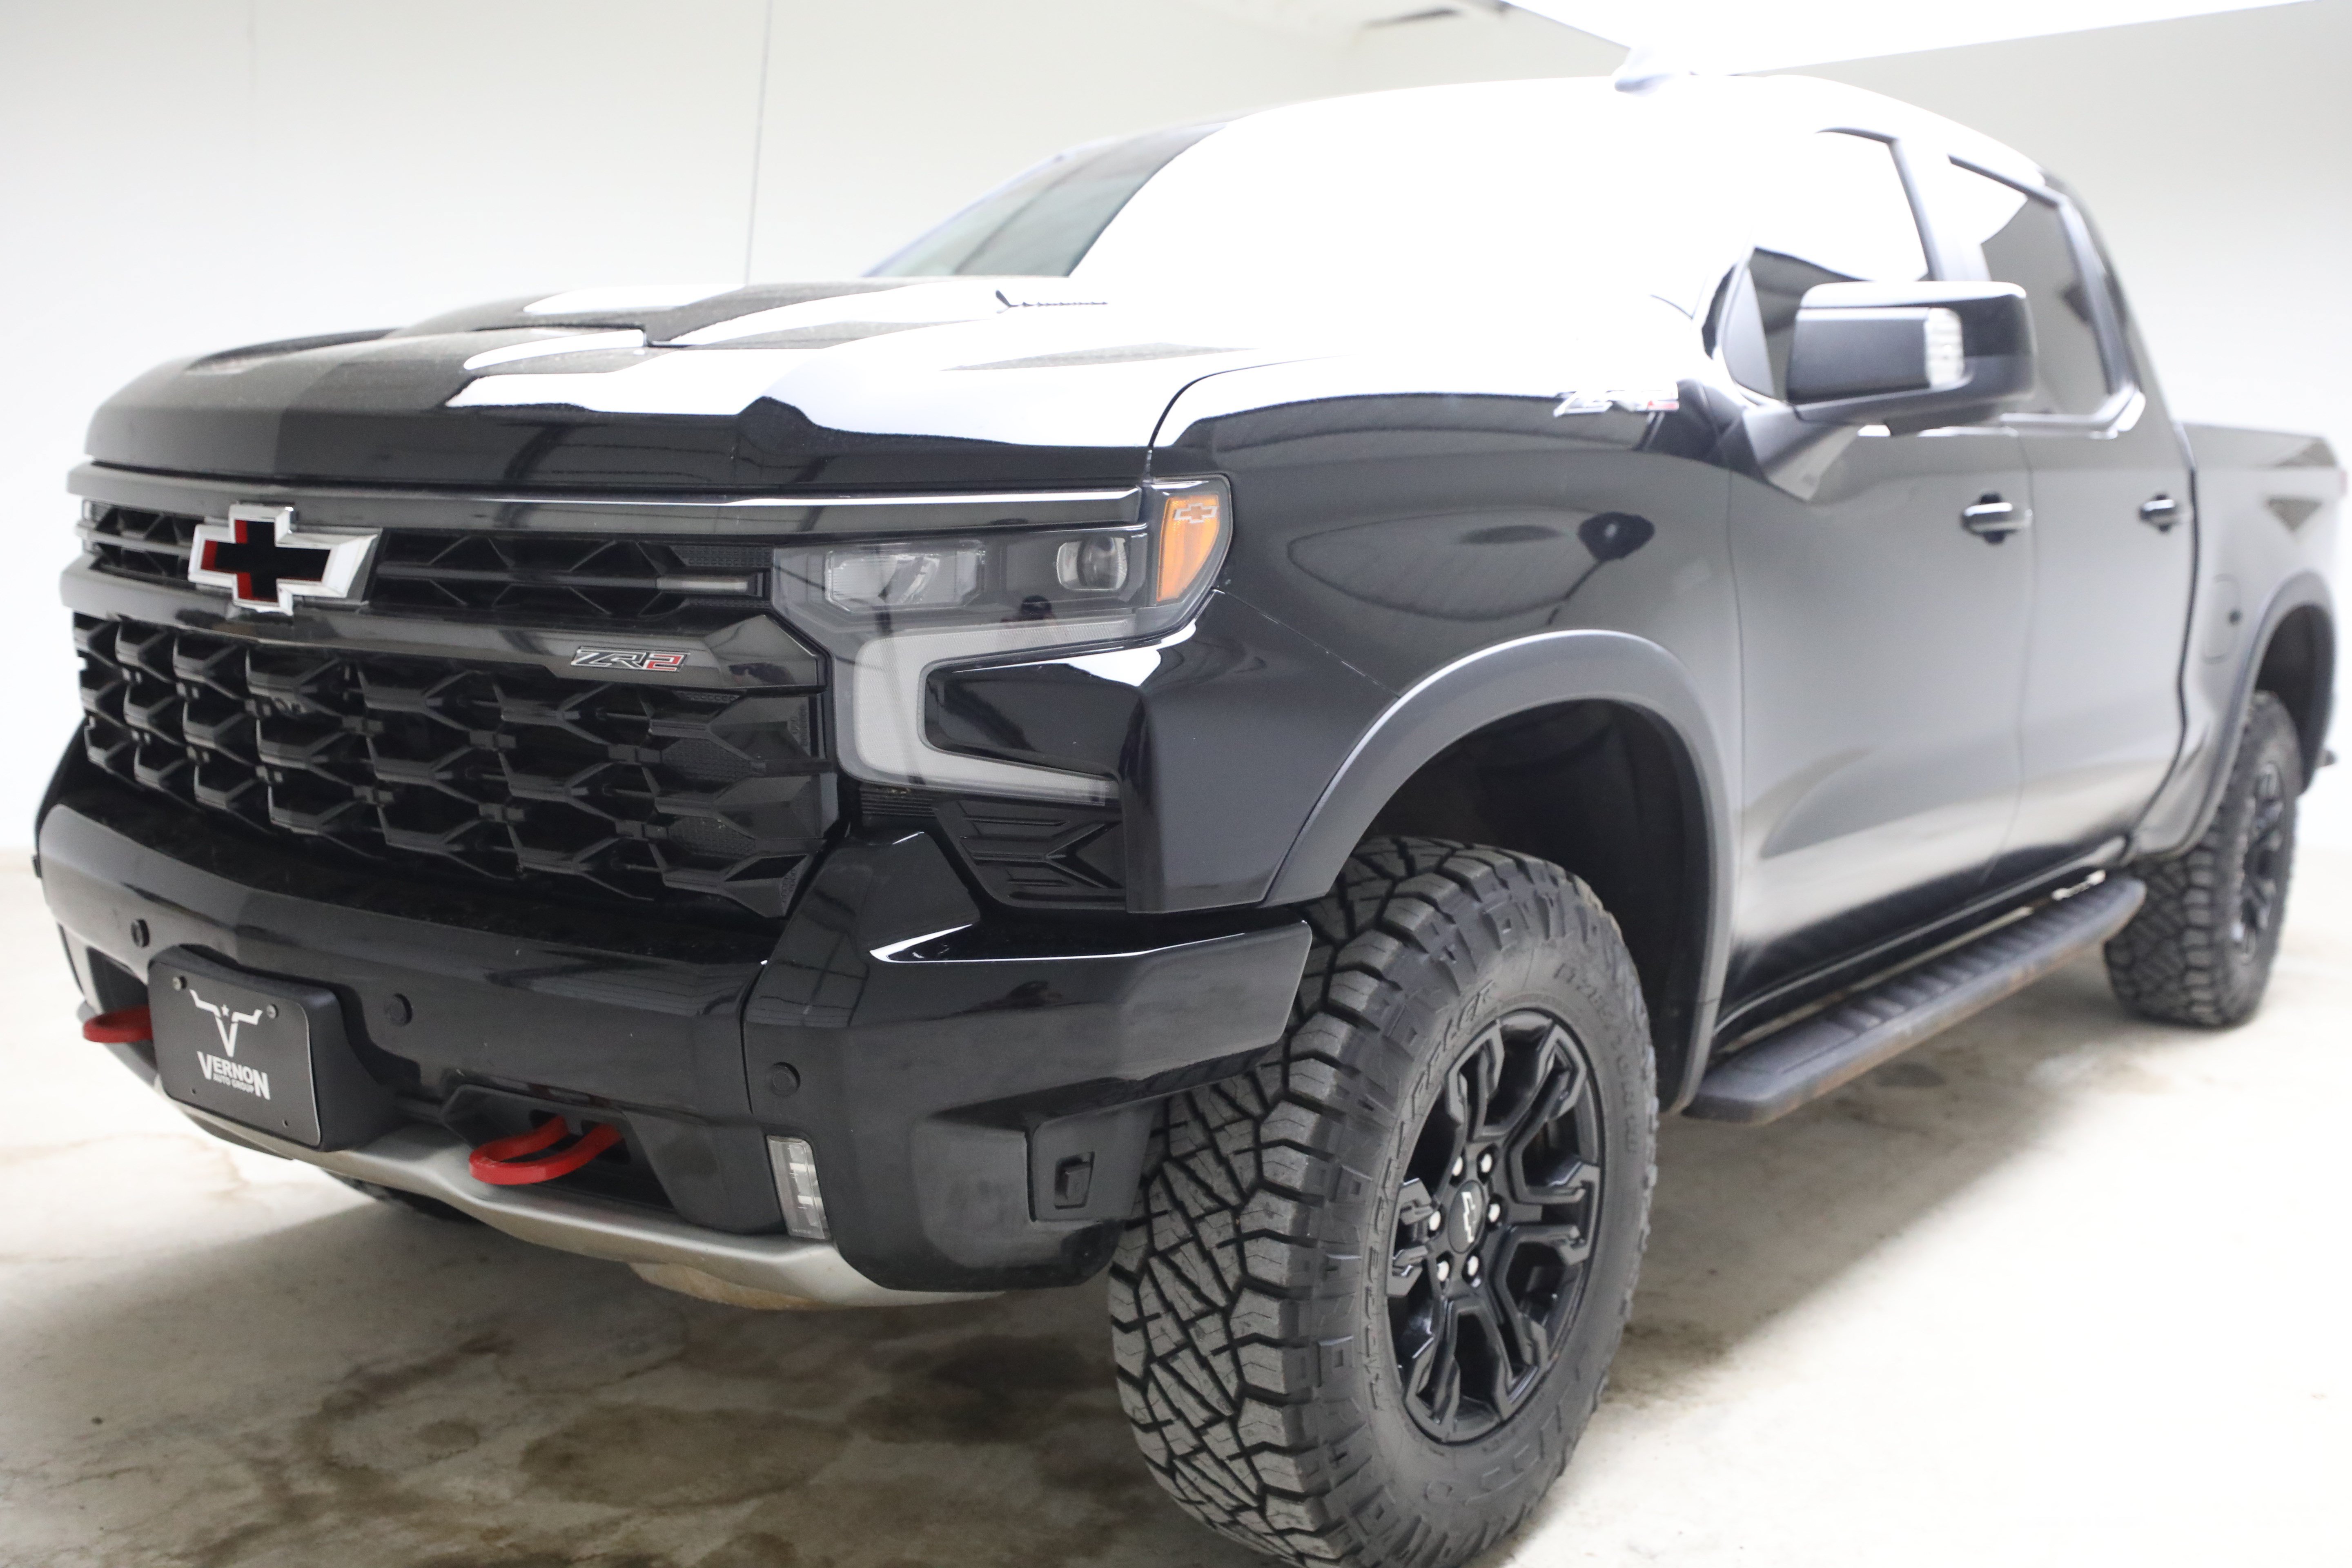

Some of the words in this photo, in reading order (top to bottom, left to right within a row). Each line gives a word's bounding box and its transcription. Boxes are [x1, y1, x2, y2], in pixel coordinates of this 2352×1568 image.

[570, 647, 690, 672] ZR2
[196, 1051, 271, 1100] VERNON
[213, 1072, 231, 1086] AUTO
[231, 1078, 255, 1094] GROUP
